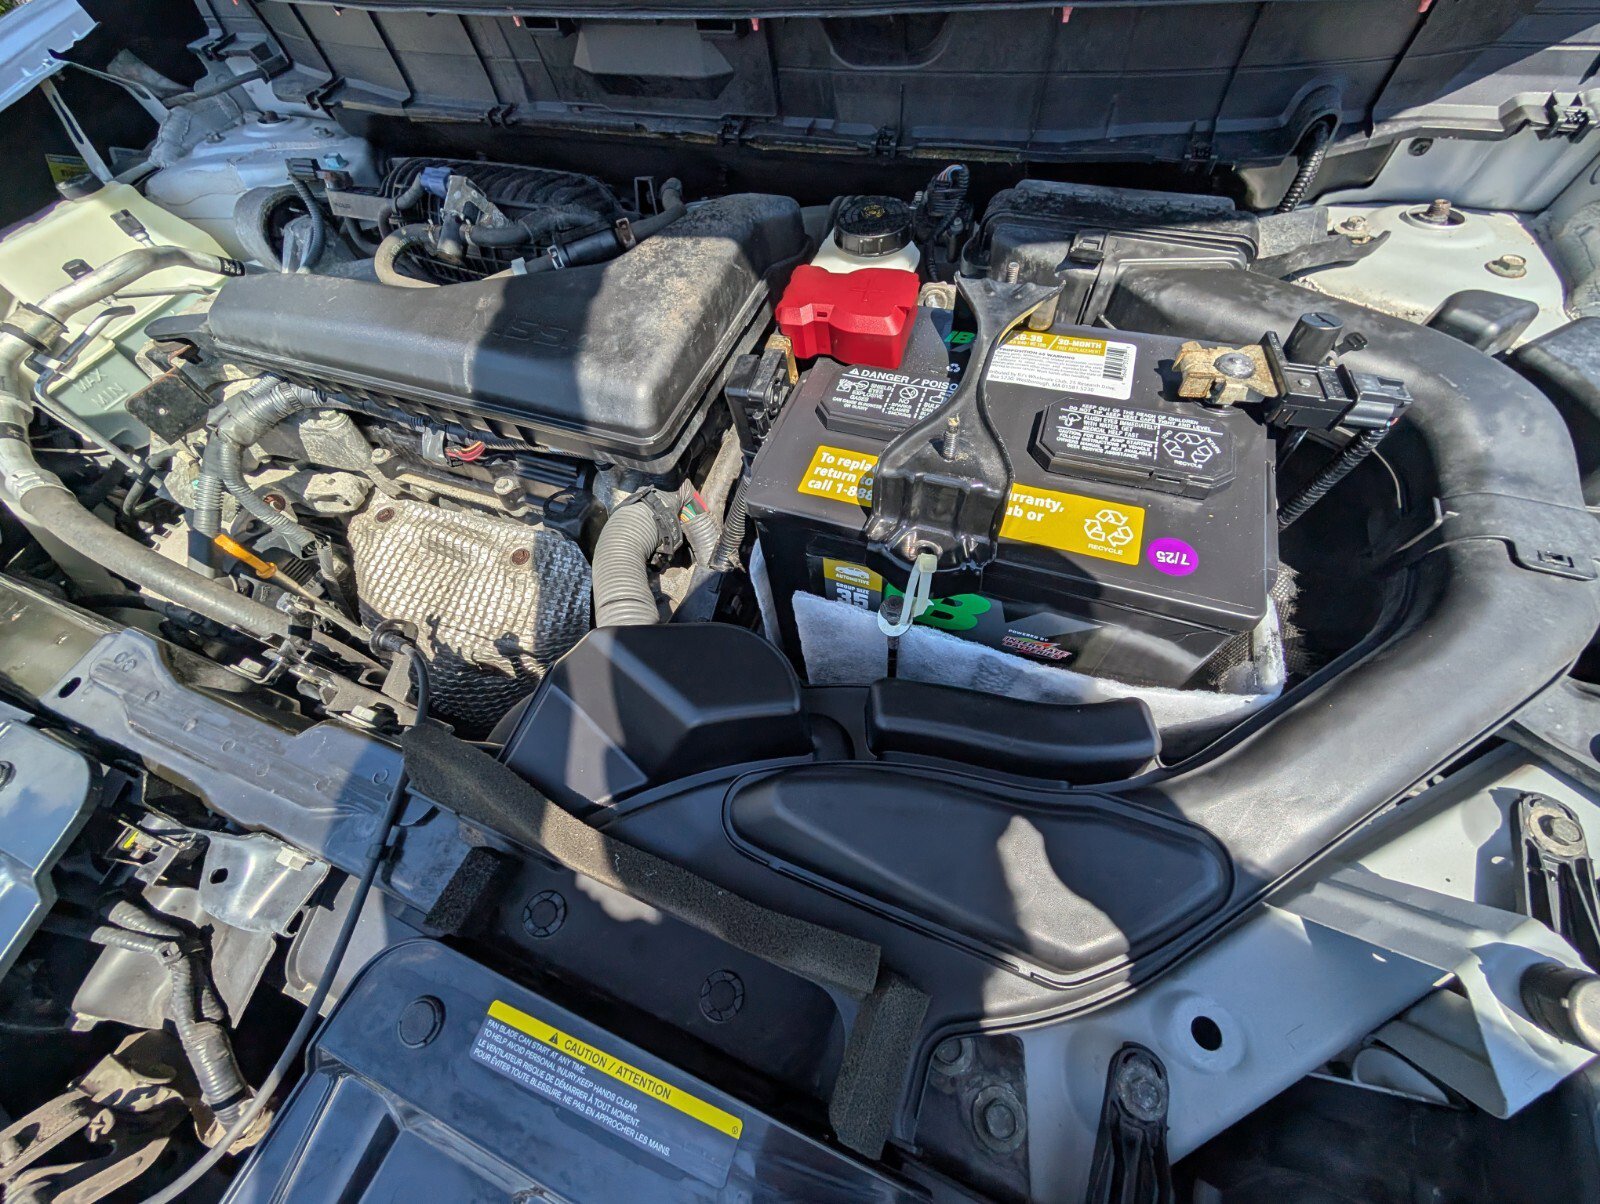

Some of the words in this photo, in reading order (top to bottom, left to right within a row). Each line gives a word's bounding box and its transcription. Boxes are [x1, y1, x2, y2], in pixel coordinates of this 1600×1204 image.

[1057, 338, 1103, 349] 30-MONTH
[72, 368, 108, 394] MAX
[861, 369, 909, 383] DANGER
[921, 378, 958, 391] POISO
[90, 382, 126, 407] MIN
[1119, 420, 1157, 431] IMMEDIATELY
[1168, 416, 1199, 425] CHILDREN
[821, 452, 835, 464] To
[837, 457, 877, 473] repla
[808, 480, 833, 491] call
[814, 467, 857, 483] return
[860, 476, 874, 487] to
[1005, 505, 1024, 518] ub
[1026, 511, 1045, 522] or
[1088, 543, 1123, 555] RECYCLE
[1156, 551, 1190, 565] 7/25
[836, 573, 870, 586] AUTOMOTIVE
[836, 582, 856, 591] GROUP
[856, 587, 870, 595] SIZE
[836, 588, 869, 610] 35
[487, 1020, 499, 1029] FAN
[499, 1026, 518, 1039] BLADE
[518, 1035, 531, 1046] CAN
[531, 1042, 550, 1055] START
[550, 1051, 558, 1059] AT
[558, 1055, 571, 1065] ANY
[571, 1061, 587, 1074] TIME.
[483, 1029, 491, 1037] TO
[491, 1033, 507, 1045] HELP
[507, 1041, 525, 1054] AVOID
[524, 1050, 557, 1070] PERSONAL
[593, 1084, 616, 1100] HANDS
[615, 1096, 639, 1112] CLEAR.
[564, 1039, 607, 1066] CAUTION
[608, 1061, 615, 1070] /
[616, 1064, 671, 1099] ATTENTION
[478, 1039, 486, 1047] LE
[485, 1043, 523, 1066] VENTILATEUR
[522, 1062, 545, 1078] RISQUE
[545, 1073, 554, 1083] DE
[554, 1076, 589, 1100] DÉMARRER
[587, 1093, 595, 1103] À
[593, 1098, 610, 1111] TOUT
[610, 1107, 641, 1127] MOMENT.
[473, 1048, 491, 1061] POUR
[491, 1056, 511, 1071] ÉVITER
[510, 1067, 530, 1081] TOUTE
[529, 1077, 564, 1100] BLESSURE,
[563, 1094, 572, 1104] NE
[572, 1099, 585, 1111] PAS
[586, 1106, 595, 1116] EN
[595, 1111, 635, 1137] APPROCHER
[635, 1132, 648, 1144] LES
[648, 1139, 672, 1156] MAINS.
